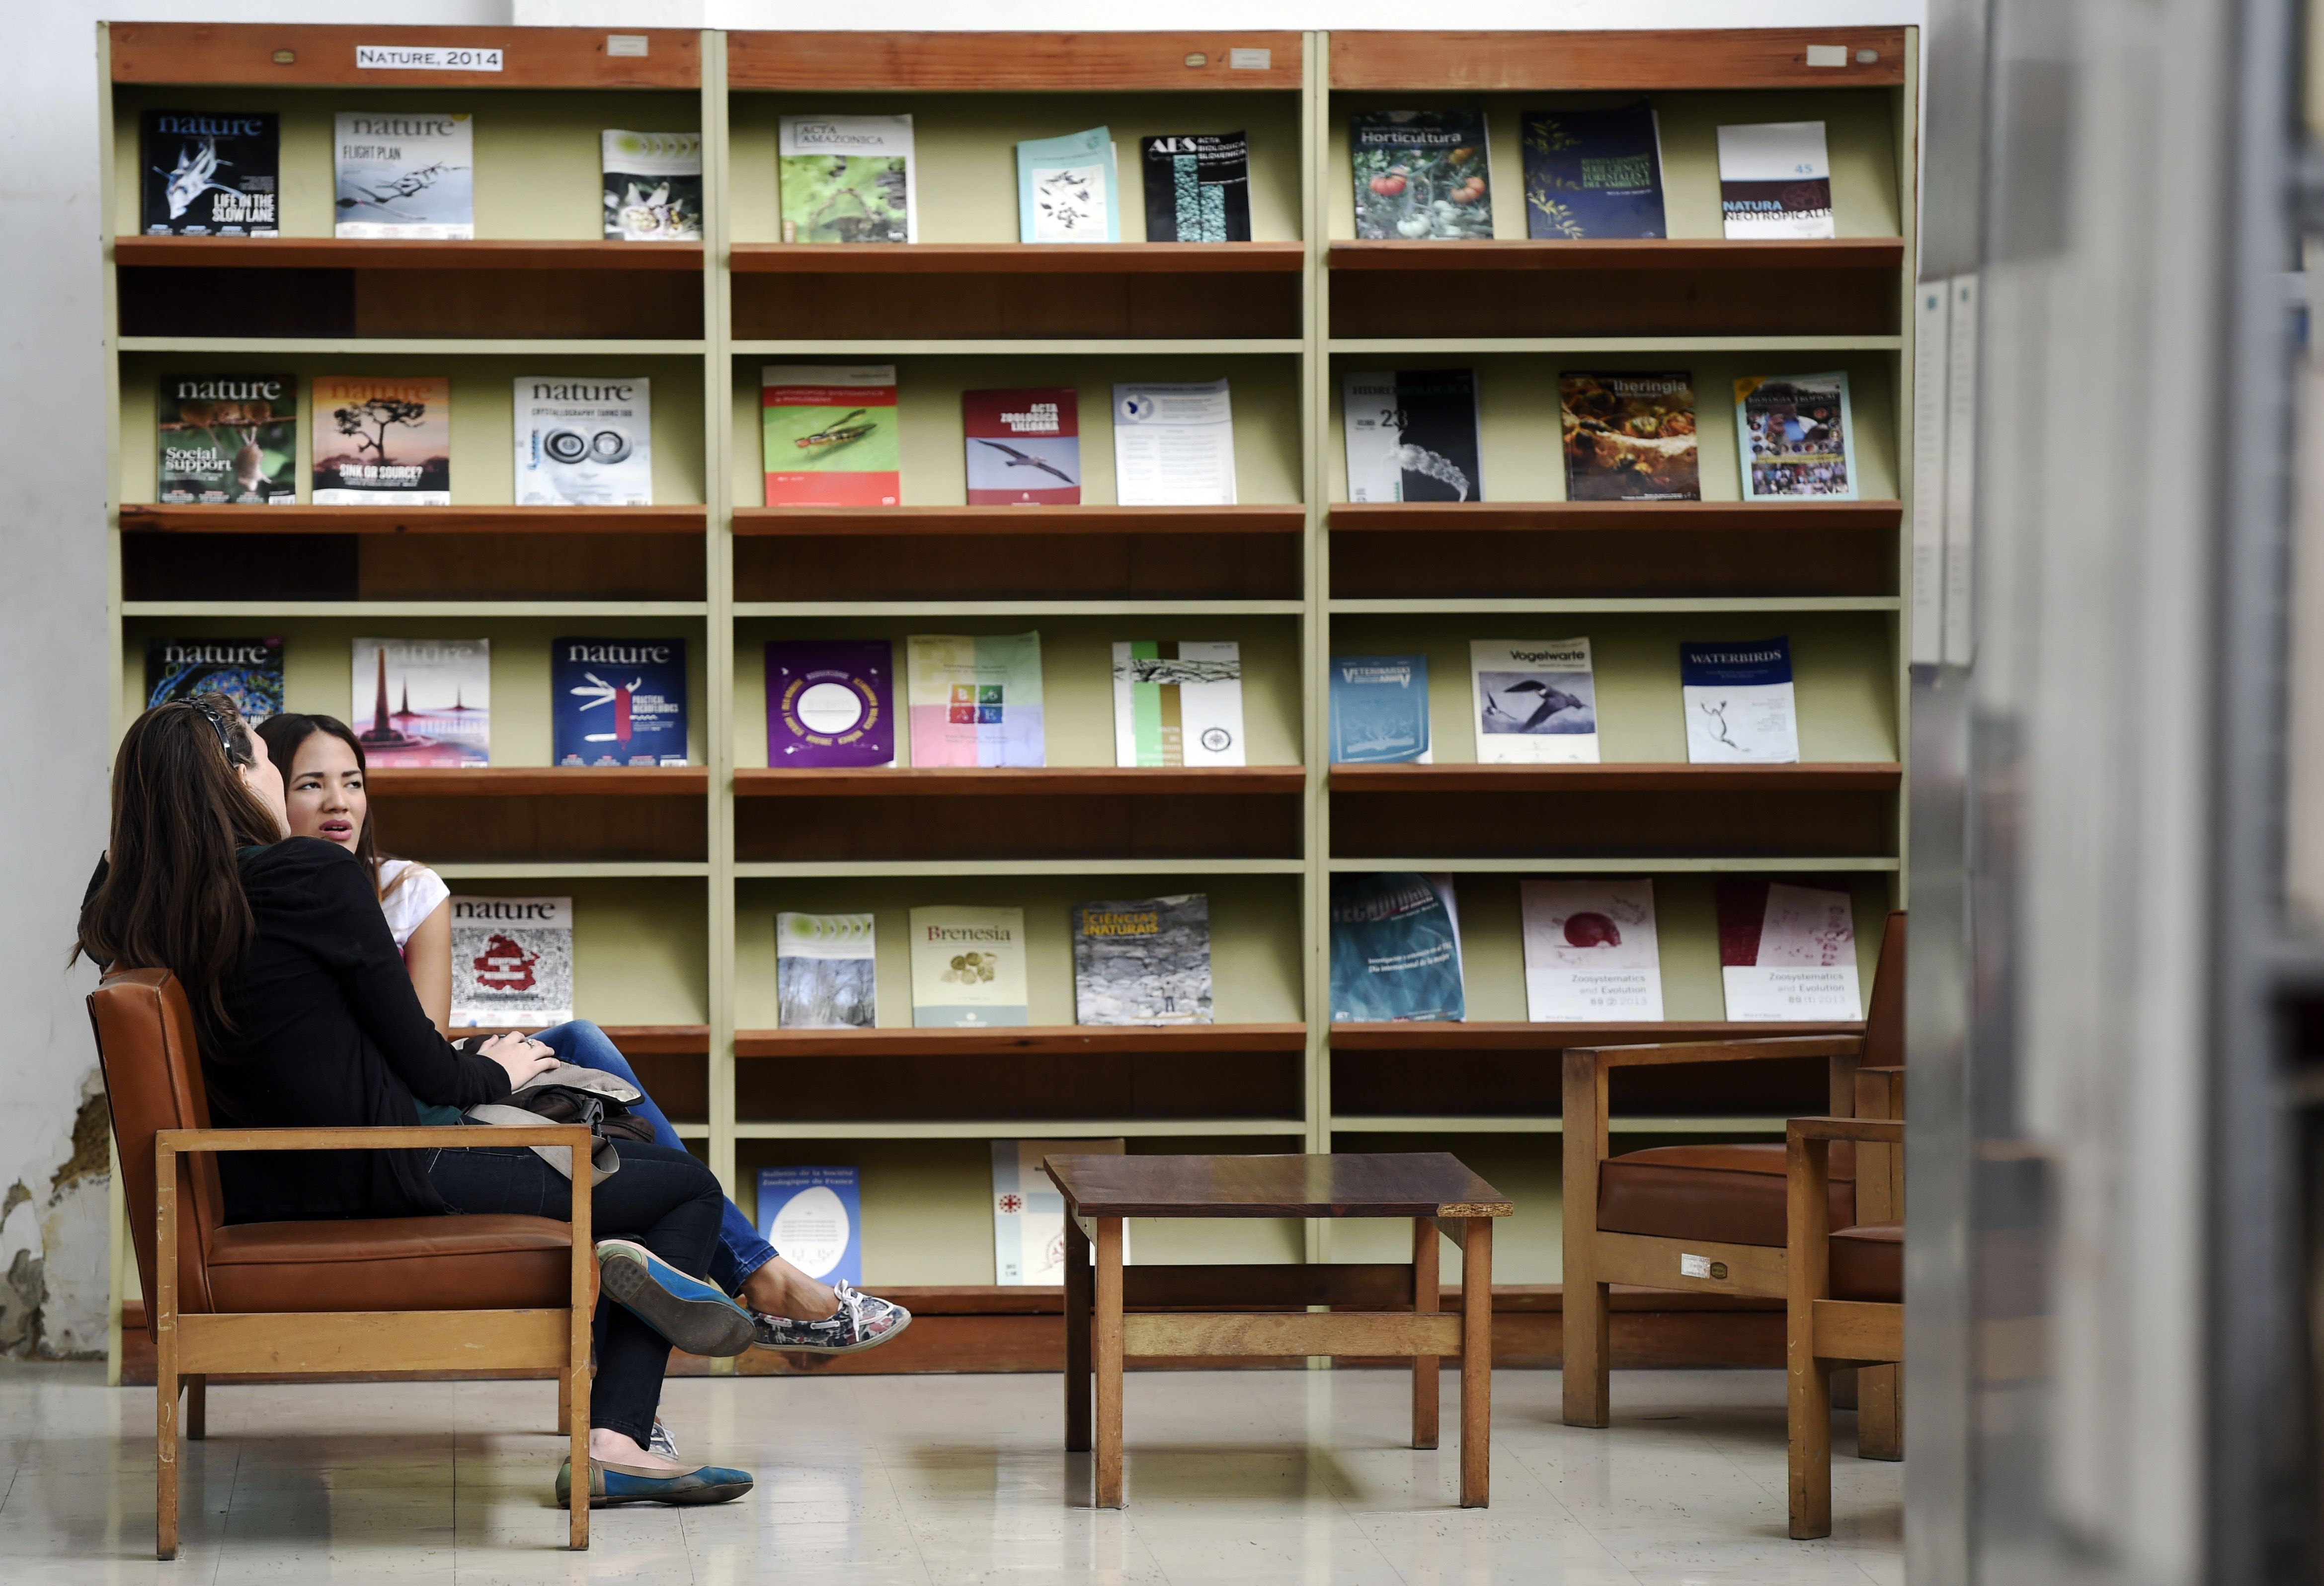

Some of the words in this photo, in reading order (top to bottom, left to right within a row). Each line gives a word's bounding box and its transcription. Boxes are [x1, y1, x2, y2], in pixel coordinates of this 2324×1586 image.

[447, 51, 497, 65] 2014
[158, 115, 263, 136] nature
[353, 118, 455, 136] nature
[801, 125, 837, 134] ACTA
[802, 135, 884, 145] AMAZONICA
[1361, 132, 1462, 143] Horticultura
[343, 145, 375, 159] FLIGHT
[377, 146, 401, 159] PLAN
[214, 193, 237, 207] LIFE
[252, 193, 275, 207] THE
[1723, 200, 1783, 211] NATURA
[212, 207, 245, 222] SLOW
[246, 208, 275, 222] LANE
[178, 380, 281, 400] nature
[331, 384, 433, 401] nature
[533, 383, 633, 401] nature
[1614, 380, 1687, 394] Iheringia
[165, 447, 217, 460] Social
[339, 464, 362, 478] SINK
[364, 465, 379, 479] OR
[379, 466, 423, 480] SOURCE?
[164, 645, 268, 664] nature
[569, 644, 670, 663] nature
[1510, 650, 1585, 663] Vogelwarte
[1690, 649, 1782, 664] WATERBIRDS
[455, 901, 556, 920] nature
[927, 925, 1011, 941] Brenesia
[1572, 974, 1646, 983] Zoosystematics
[1769, 972, 1844, 982] Zoosystematics
[1602, 986, 1646, 994] Evolution
